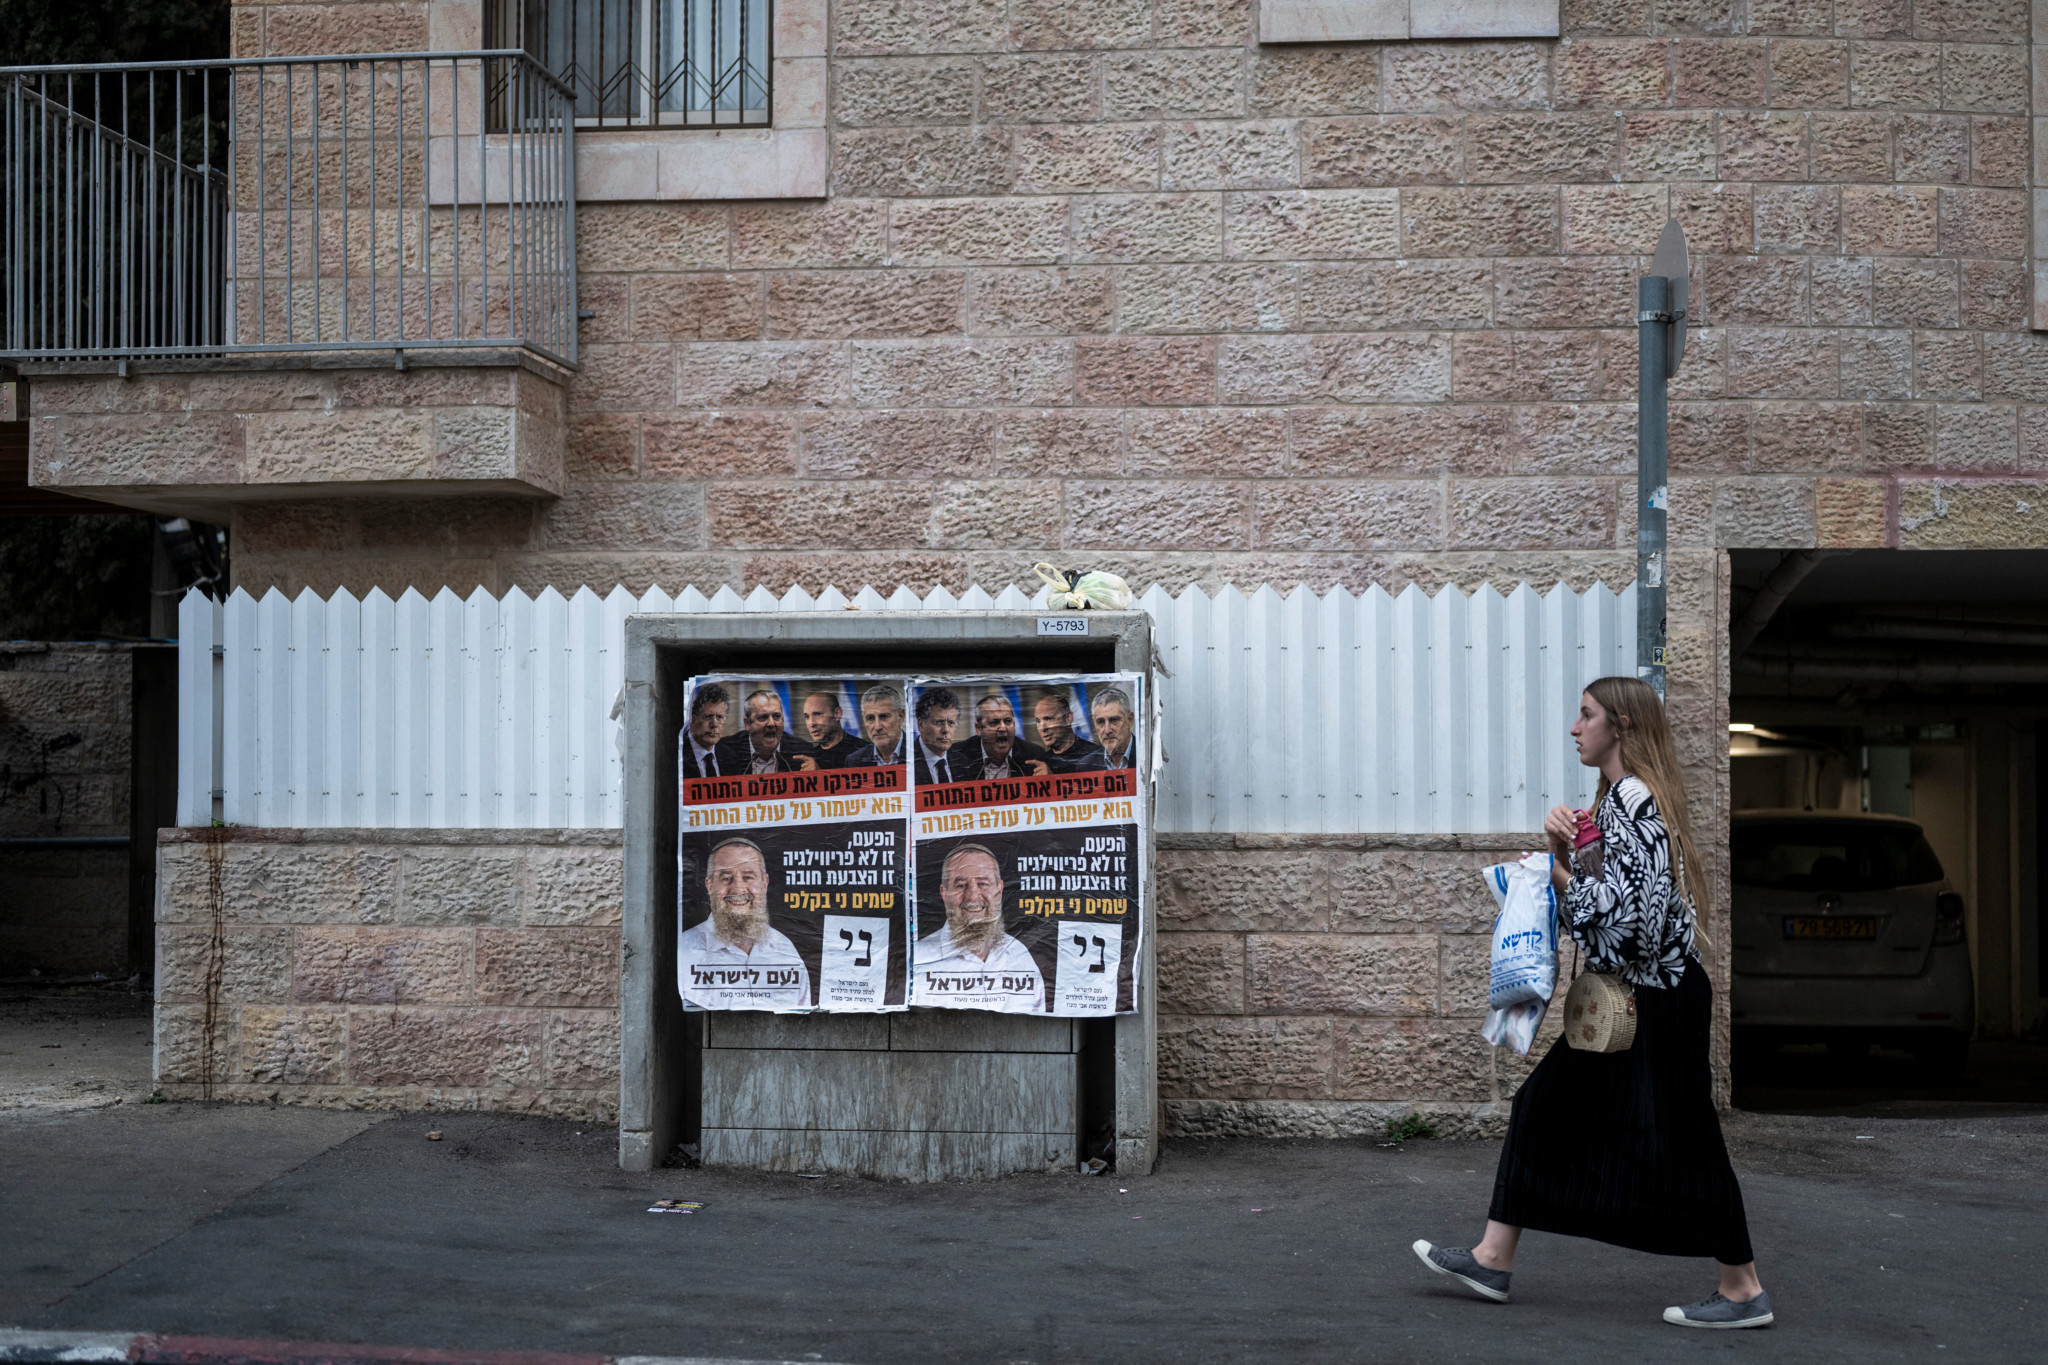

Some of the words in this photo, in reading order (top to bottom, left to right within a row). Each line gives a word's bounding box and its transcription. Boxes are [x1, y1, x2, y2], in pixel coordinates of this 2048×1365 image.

[1042, 620, 1085, 631] Y-5793
[748, 777, 787, 797] עולם
[793, 775, 818, 793] את
[823, 772, 868, 794] יפרקו
[873, 771, 897, 788] הם
[1026, 779, 1051, 798] את
[1056, 777, 1099, 799] יפרקו
[1104, 775, 1127, 793] הם
[691, 781, 743, 800] התורה
[923, 786, 976, 807] התורה
[981, 781, 1021, 802] עולם
[746, 803, 785, 823] עולם
[790, 800, 812, 820] על
[817, 798, 868, 818] ישמור
[871, 796, 902, 814] הוא
[1051, 803, 1098, 824] ישמור
[1103, 801, 1133, 820] הוא
[689, 806, 741, 827] התורה
[921, 813, 974, 834] התורה
[979, 808, 1019, 829] עולם
[1023, 806, 1046, 825] על
[847, 831, 895, 850] הפעם,
[1080, 836, 1126, 855] הפעם,
[783, 848, 855, 866] פריווילגיה
[858, 848, 879, 866] לא
[882, 850, 895, 866] זו
[1017, 854, 1087, 872] פריווילגיה
[1090, 854, 1111, 872] לא
[1114, 856, 1127, 872] זו
[785, 870, 822, 885] חובה
[825, 870, 878, 886] הצבעת
[882, 870, 895, 885] זו
[1020, 875, 1057, 891] חובה
[1060, 875, 1111, 891] הצבעת
[1114, 875, 1127, 891] זו
[784, 890, 831, 912] בקלפי
[835, 892, 847, 909] ני
[852, 892, 895, 909] שמים
[1019, 896, 1065, 917] בקלפי
[1069, 898, 1081, 914] ני
[1085, 898, 1128, 915] שמים
[839, 927, 873, 967] ני
[1073, 933, 1106, 974] ני
[690, 964, 760, 985] לישראל
[925, 971, 995, 991] לישראל
